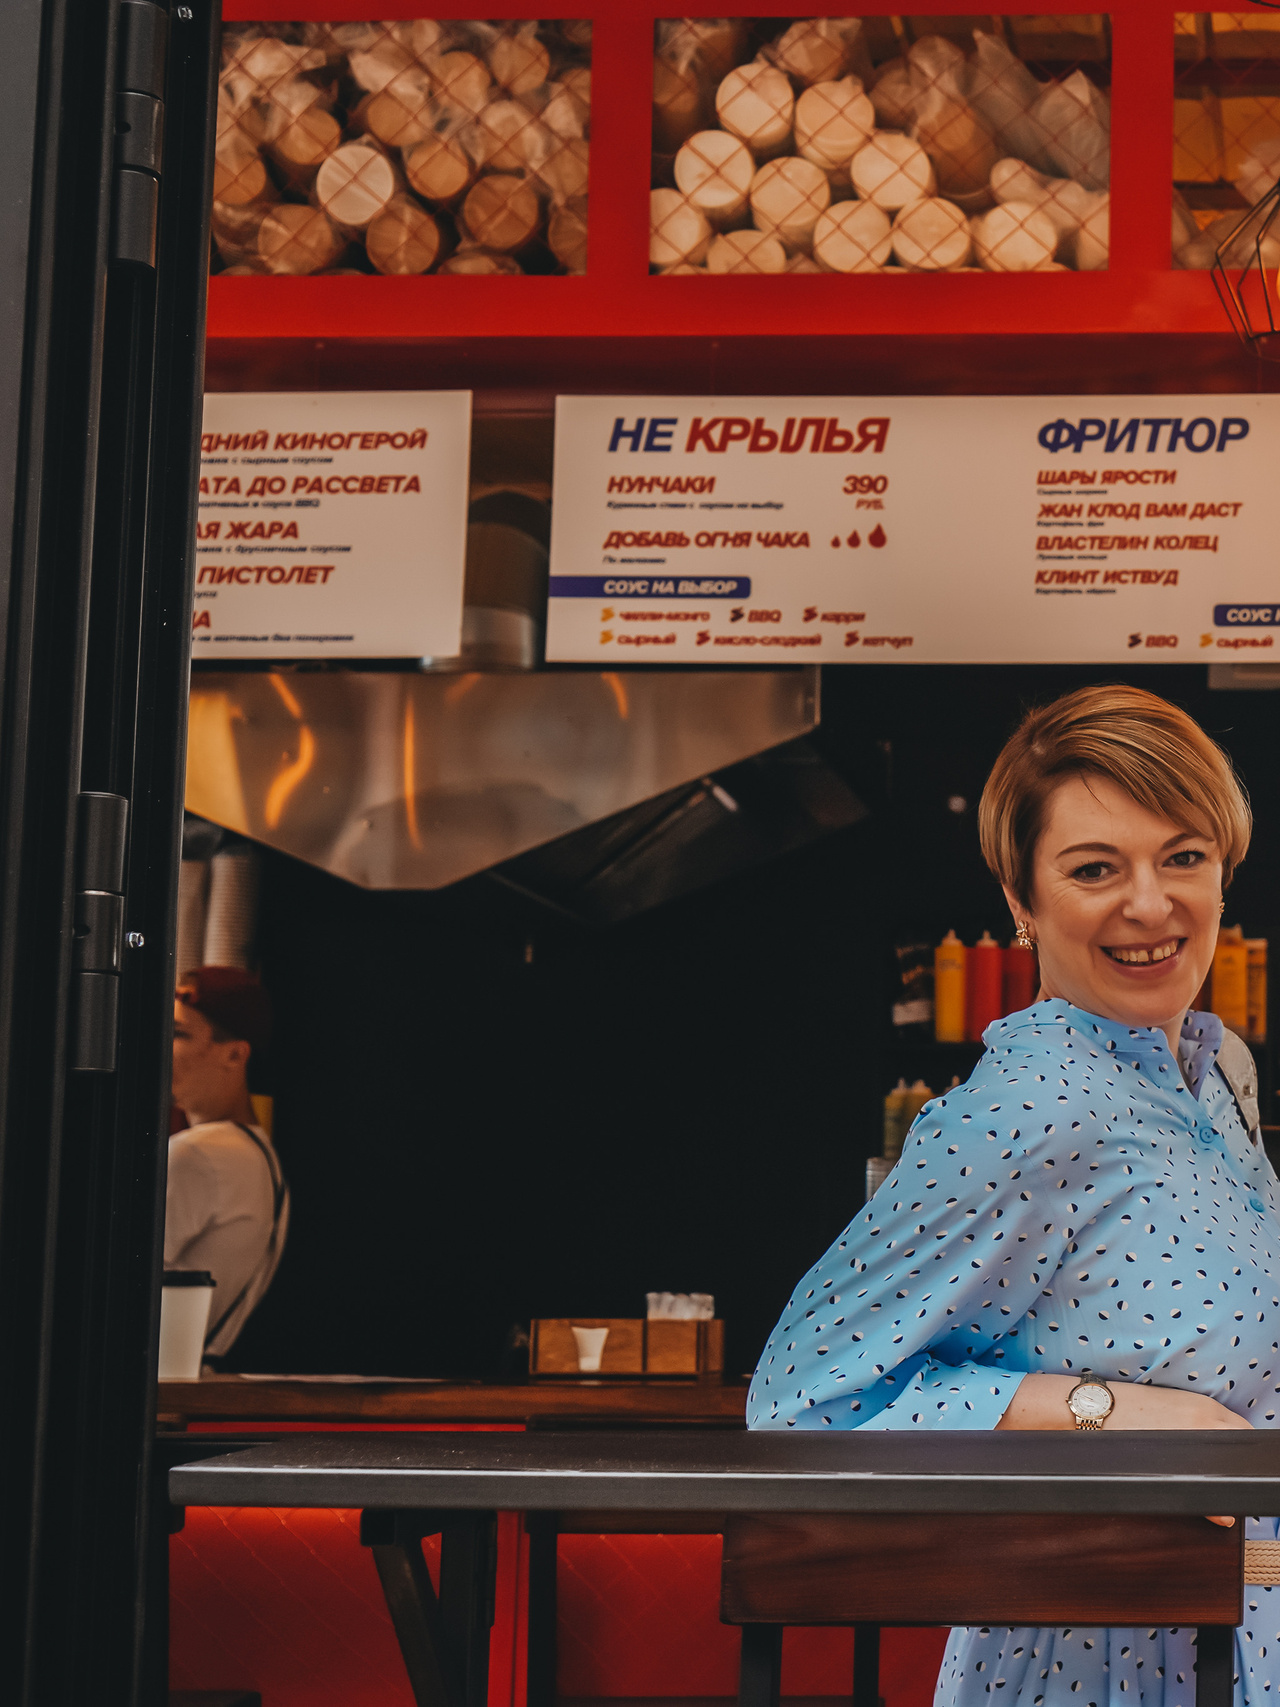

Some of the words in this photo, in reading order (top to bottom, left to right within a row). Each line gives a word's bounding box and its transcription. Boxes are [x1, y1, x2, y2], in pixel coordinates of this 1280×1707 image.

[274, 428, 429, 451] КИНОГЕРОЙ
[608, 417, 678, 452] НЕ
[685, 417, 890, 453] КРЫЛЬЯ
[1038, 416, 1250, 453] ФРИТЮР
[246, 475, 287, 497] ДО
[291, 475, 422, 495] РАССВЕТА
[606, 475, 716, 494] НУНЧАКИ
[843, 474, 888, 495] 390
[1037, 470, 1097, 485] ШАРЫ
[1100, 469, 1177, 485] ЯРОСТИ
[1038, 503, 1083, 518] ЖАН
[1088, 502, 1141, 521] КЛОД
[1145, 502, 1188, 517] ВАМ
[1189, 502, 1243, 520] ДАСТ
[224, 521, 300, 540] ЖАРА
[603, 531, 691, 549] ДОБАВЬ
[695, 531, 752, 548] ОГНЯ
[756, 531, 810, 548] ЧАКА
[1036, 535, 1149, 551] ВЛАСТЕЛИН
[1153, 535, 1219, 553] КОЛЕЦ
[197, 565, 335, 584] ПИСТОЛЕТ
[1035, 570, 1100, 586] КЛИНТ
[1103, 569, 1180, 587] ИСТВУД
[603, 580, 650, 595] СОУС
[652, 580, 675, 595] НА
[677, 580, 738, 595] ВЫБОР
[1226, 608, 1272, 623] СОУС
